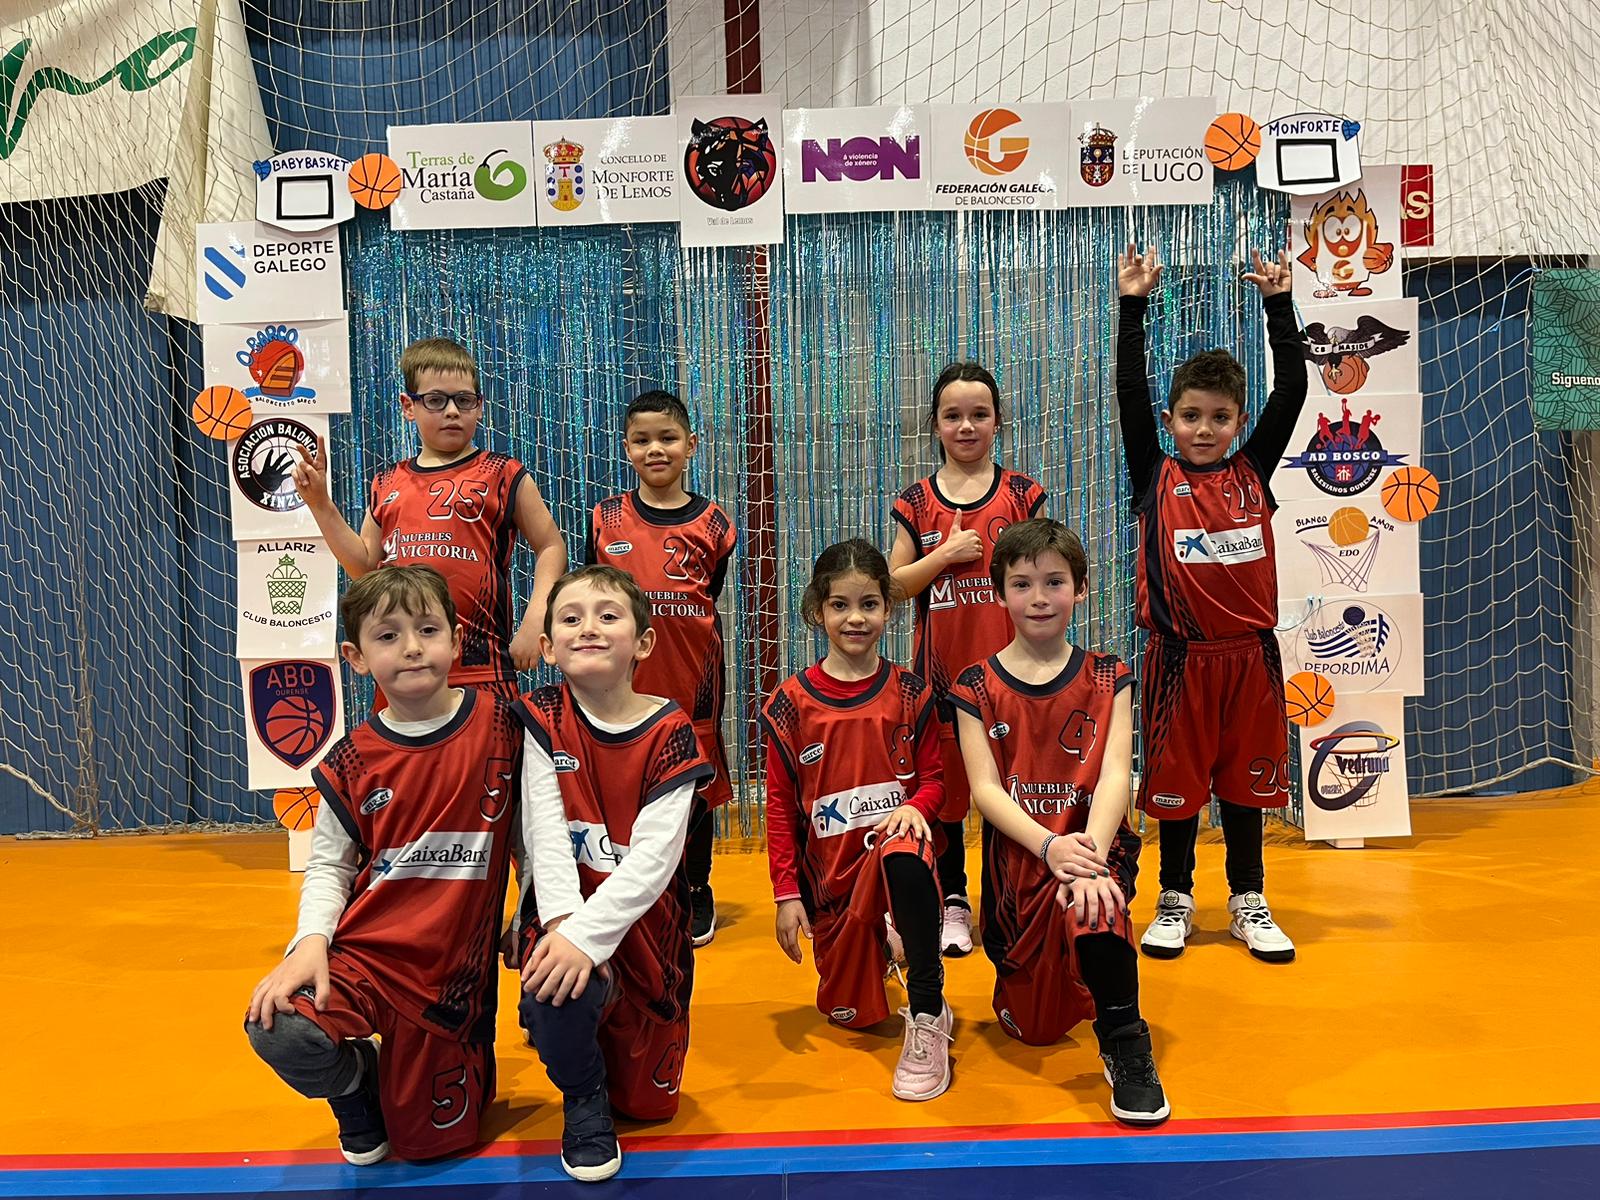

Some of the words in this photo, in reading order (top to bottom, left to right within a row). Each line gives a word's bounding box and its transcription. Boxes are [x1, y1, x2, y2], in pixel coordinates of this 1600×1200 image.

[1269, 120, 1341, 137] MONFORTE
[406, 151, 455, 169] Terras
[458, 152, 475, 165] de
[601, 154, 653, 165] CONCELLO
[654, 154, 668, 163] DE
[801, 135, 921, 183] NON
[400, 166, 472, 189] María
[592, 169, 675, 184] MONFORTE
[1141, 162, 1204, 182] LUGO
[420, 188, 475, 203] Castaña
[621, 185, 672, 199] LEMOS
[935, 182, 1008, 194] FEDERACIÓN
[955, 196, 969, 206] DE
[970, 195, 1035, 206] BALONCESTO
[253, 240, 335, 257] DEPORTE
[254, 257, 326, 273] GALEGO
[238, 424, 275, 480] ASOCIACION
[1308, 452, 1328, 462] AD
[1332, 451, 1381, 461] BOSCO
[1310, 467, 1349, 494] SALESIANOS
[1349, 467, 1378, 493] OURENSE
[426, 478, 489, 523] 25
[1296, 515, 1328, 527] BLANCO
[1370, 516, 1395, 532] AMOR
[401, 532, 453, 543] MUEBLES
[257, 541, 316, 554] ALLARIZ
[401, 544, 479, 562] VICTORIA
[1339, 549, 1360, 557] EDO
[651, 603, 706, 617] ICTORIA
[242, 610, 268, 625] CLUB
[269, 610, 332, 628] BALONCESTO
[1304, 657, 1390, 676] DEPORDIMA
[266, 665, 316, 689] ABO
[1058, 709, 1097, 764] 4
[479, 757, 513, 823] 5
[431, 1065, 468, 1130] 5
